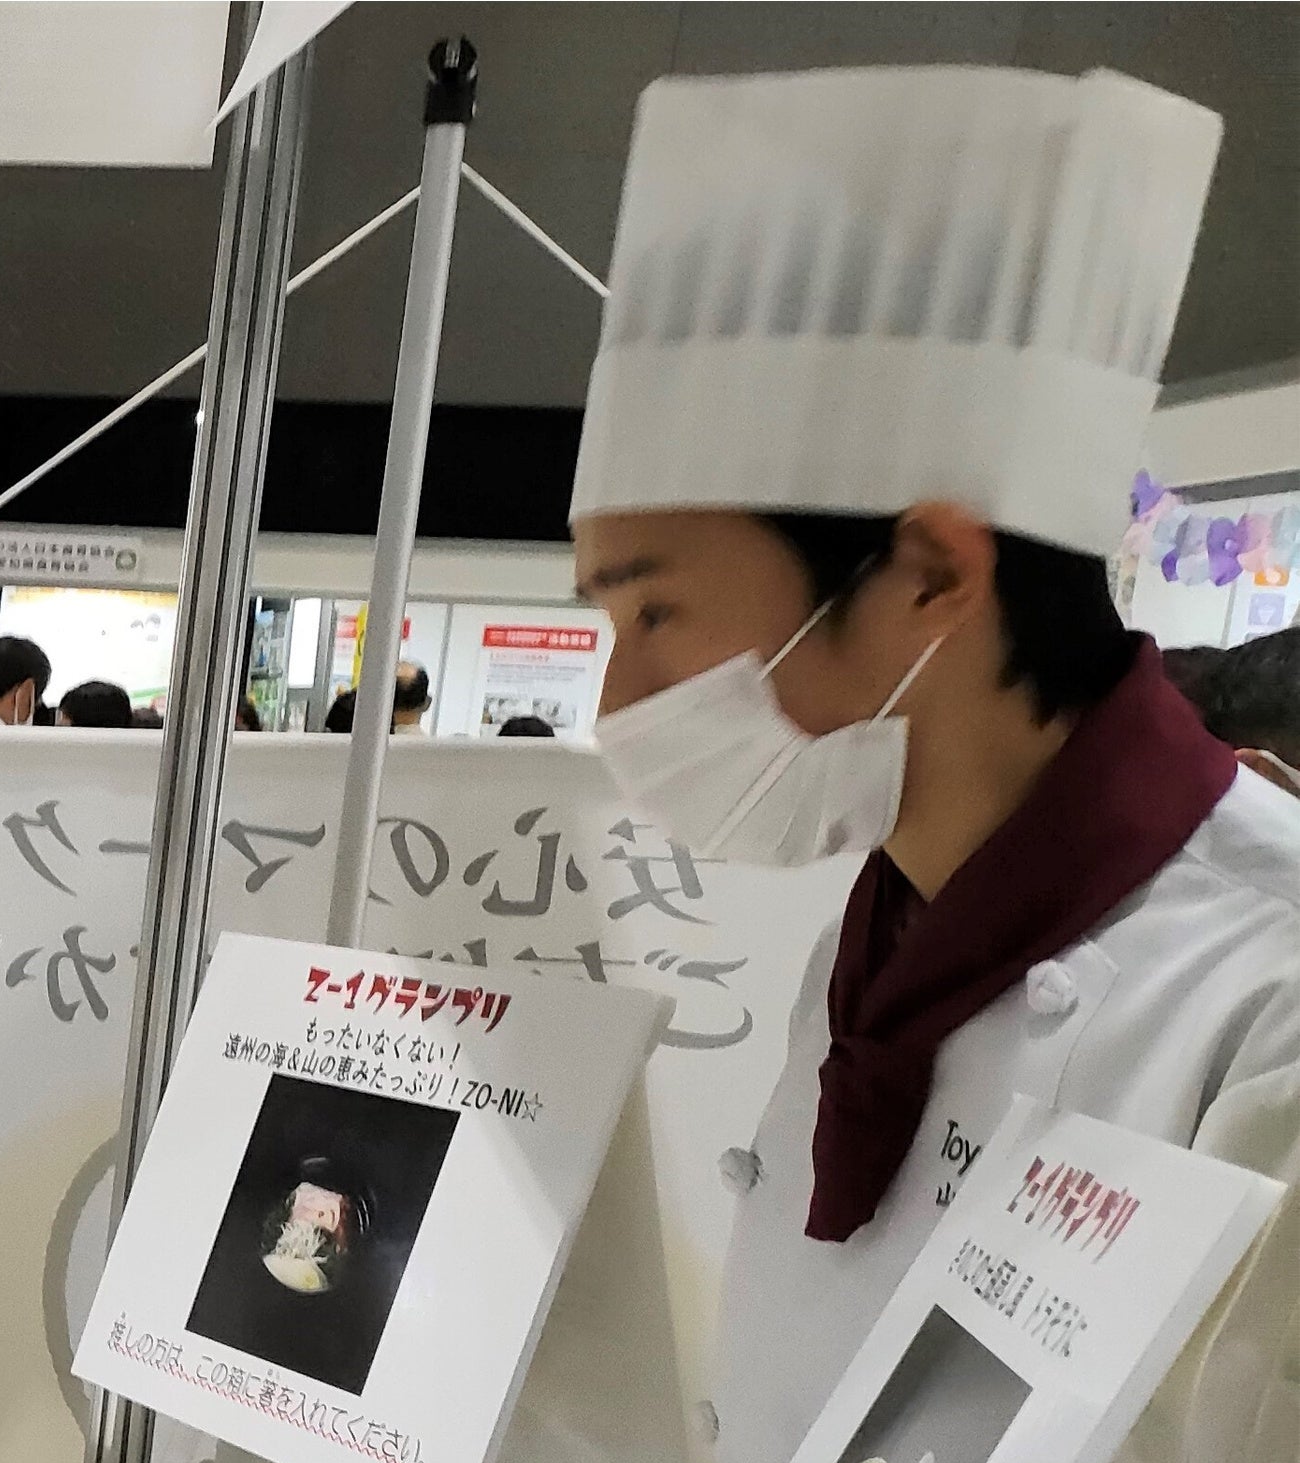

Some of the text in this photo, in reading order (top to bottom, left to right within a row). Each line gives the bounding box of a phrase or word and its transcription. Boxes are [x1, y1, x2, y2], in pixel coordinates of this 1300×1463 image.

[303, 965, 513, 1034] Z-1グランプリ
[305, 1017, 462, 1070] もったいなくない！
[940, 1119, 982, 1177] Toy
